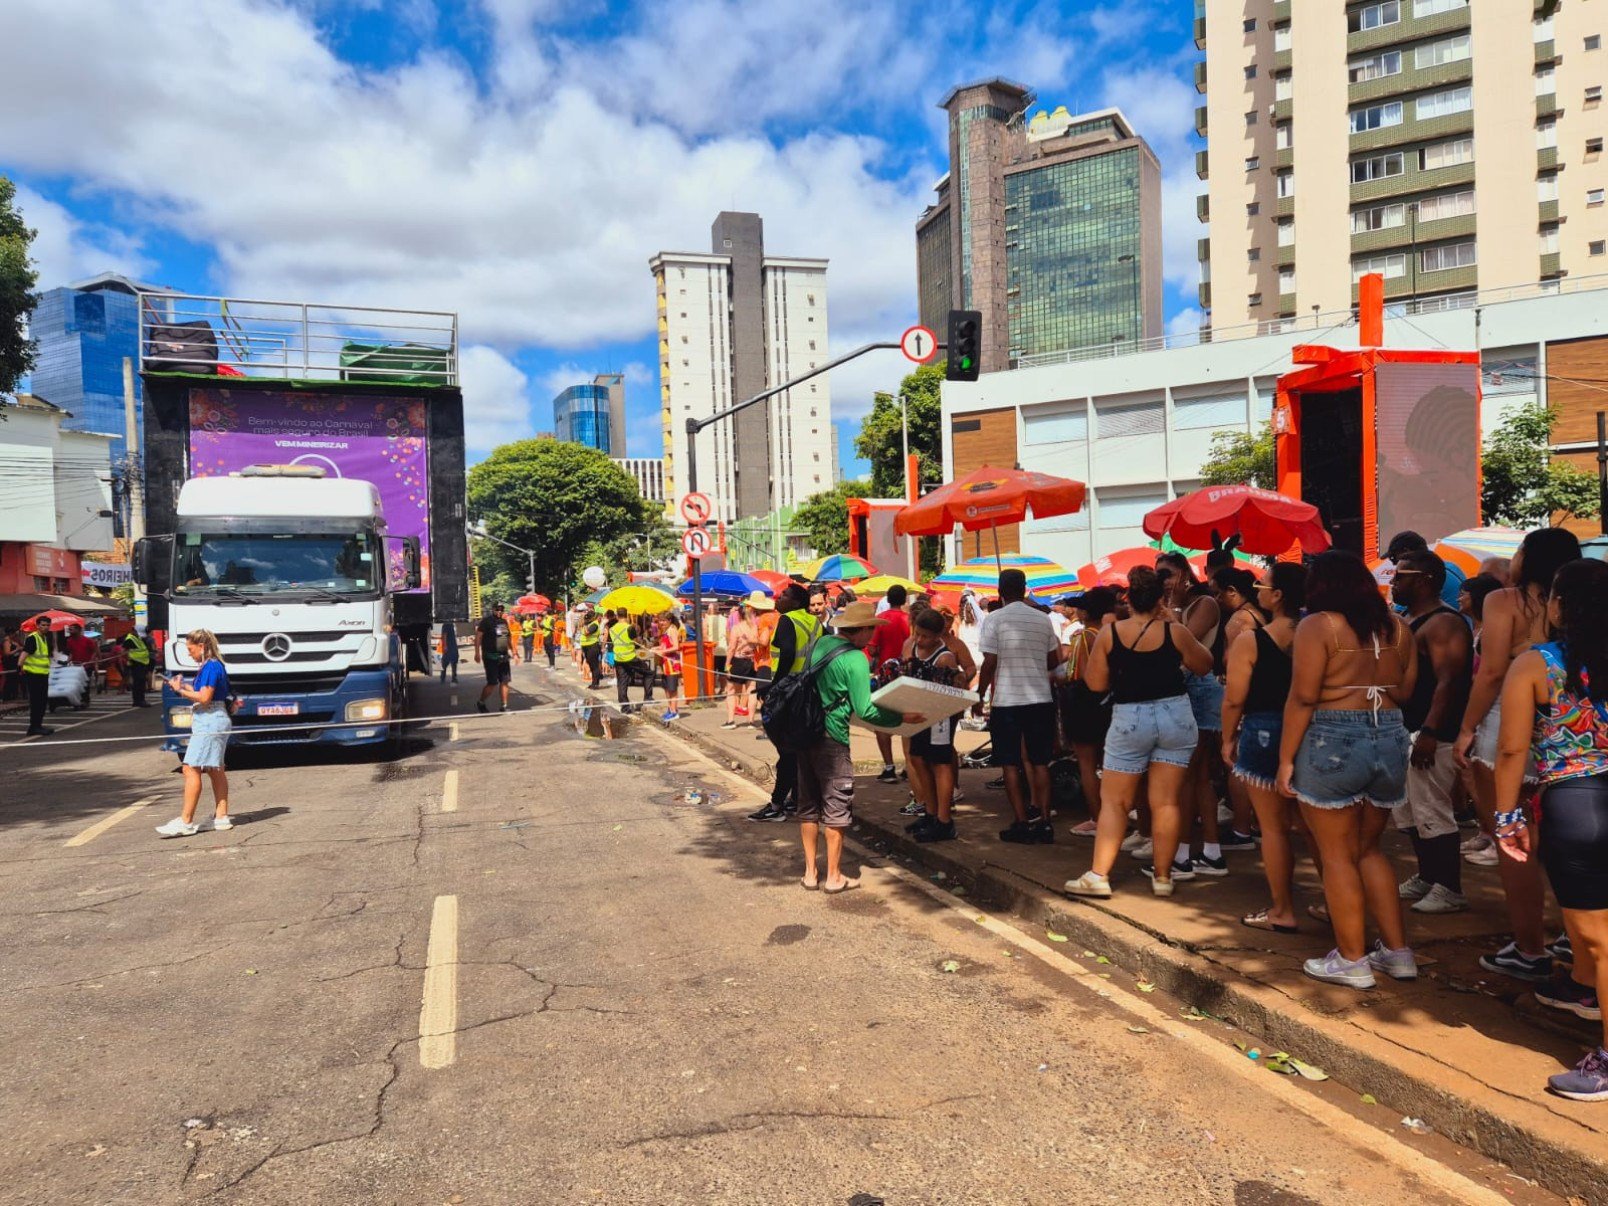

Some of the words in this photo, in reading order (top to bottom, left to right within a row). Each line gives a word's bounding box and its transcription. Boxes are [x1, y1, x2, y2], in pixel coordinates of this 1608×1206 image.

[248, 416, 307, 427] Bem-vindo
[309, 420, 323, 428] ao
[324, 419, 373, 429] Carnaval
[1276, 411, 1285, 429] 5
[253, 426, 279, 435] mais
[323, 428, 337, 437] do
